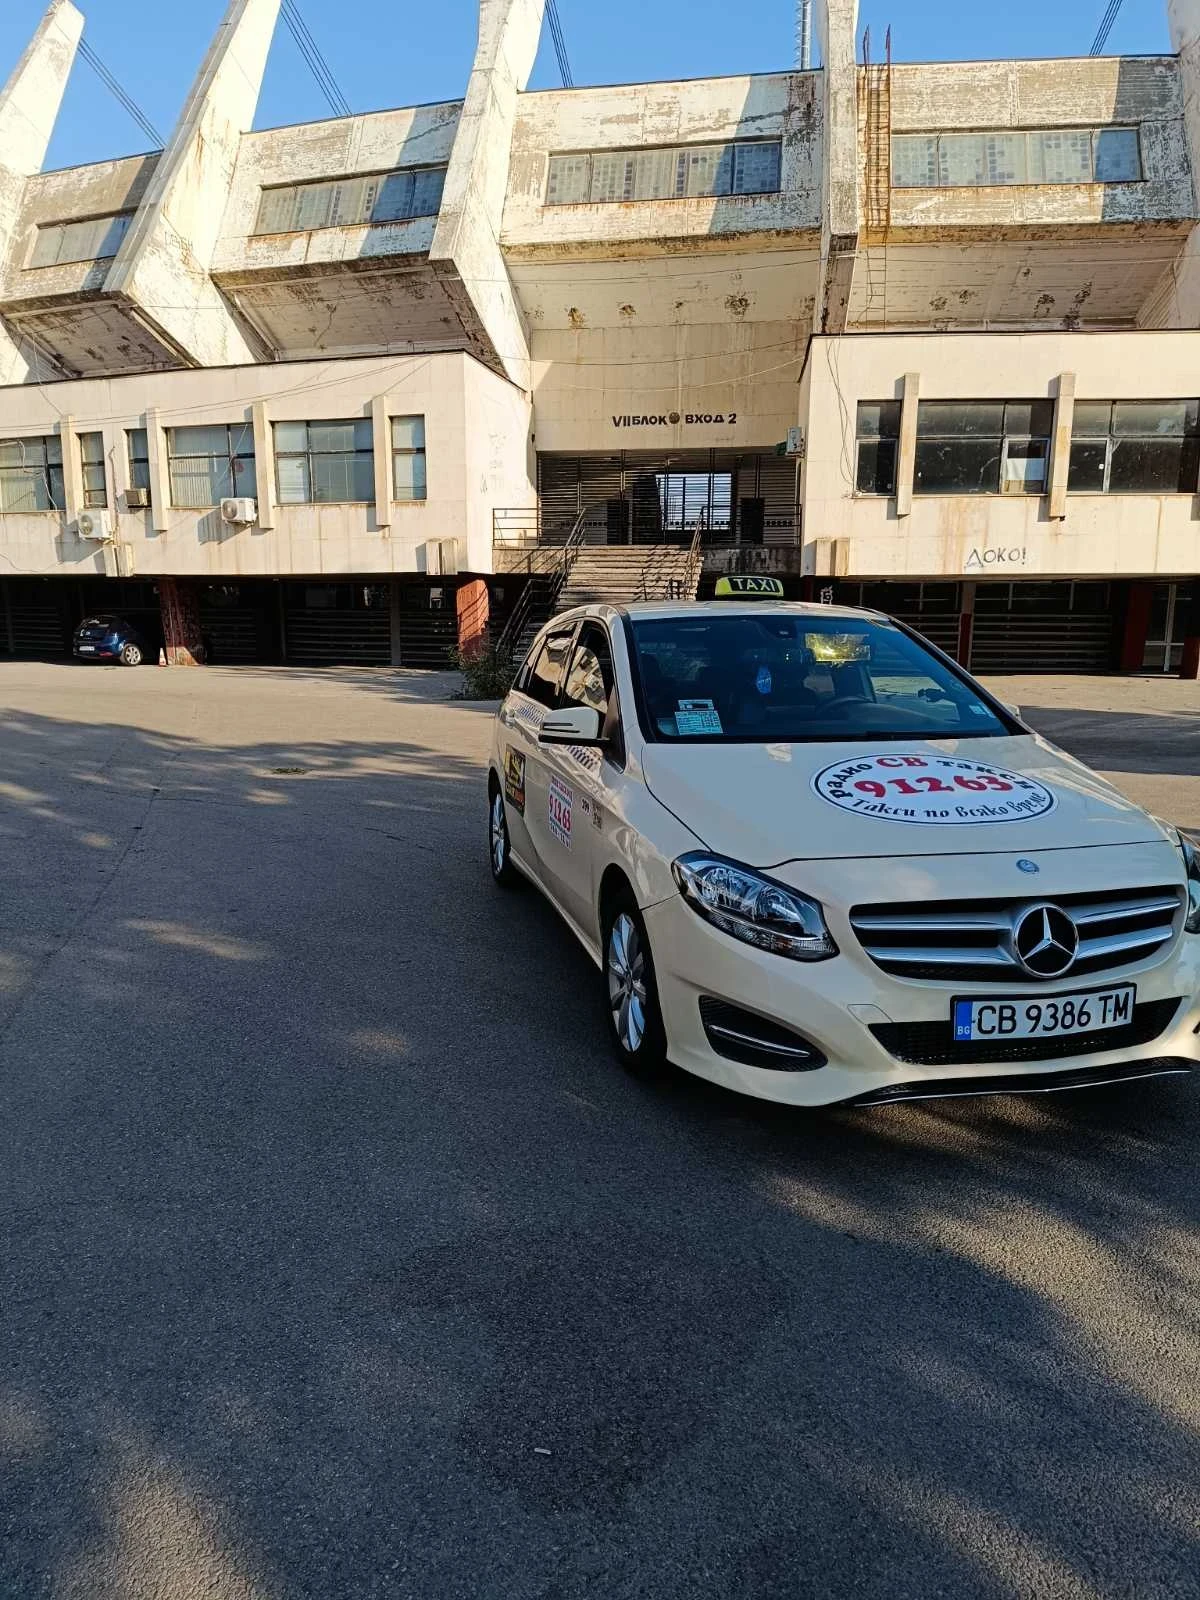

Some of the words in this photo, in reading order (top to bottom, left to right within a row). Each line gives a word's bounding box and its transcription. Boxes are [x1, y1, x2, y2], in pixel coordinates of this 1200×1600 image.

[685, 414, 724, 424] ВХОД
[728, 413, 737, 424] 2
[733, 578, 776, 592] TAXI
[876, 757, 928, 768] СВ
[924, 809, 950, 818] по
[957, 1026, 970, 1035] BG
[1025, 998, 1091, 1034] 9386
